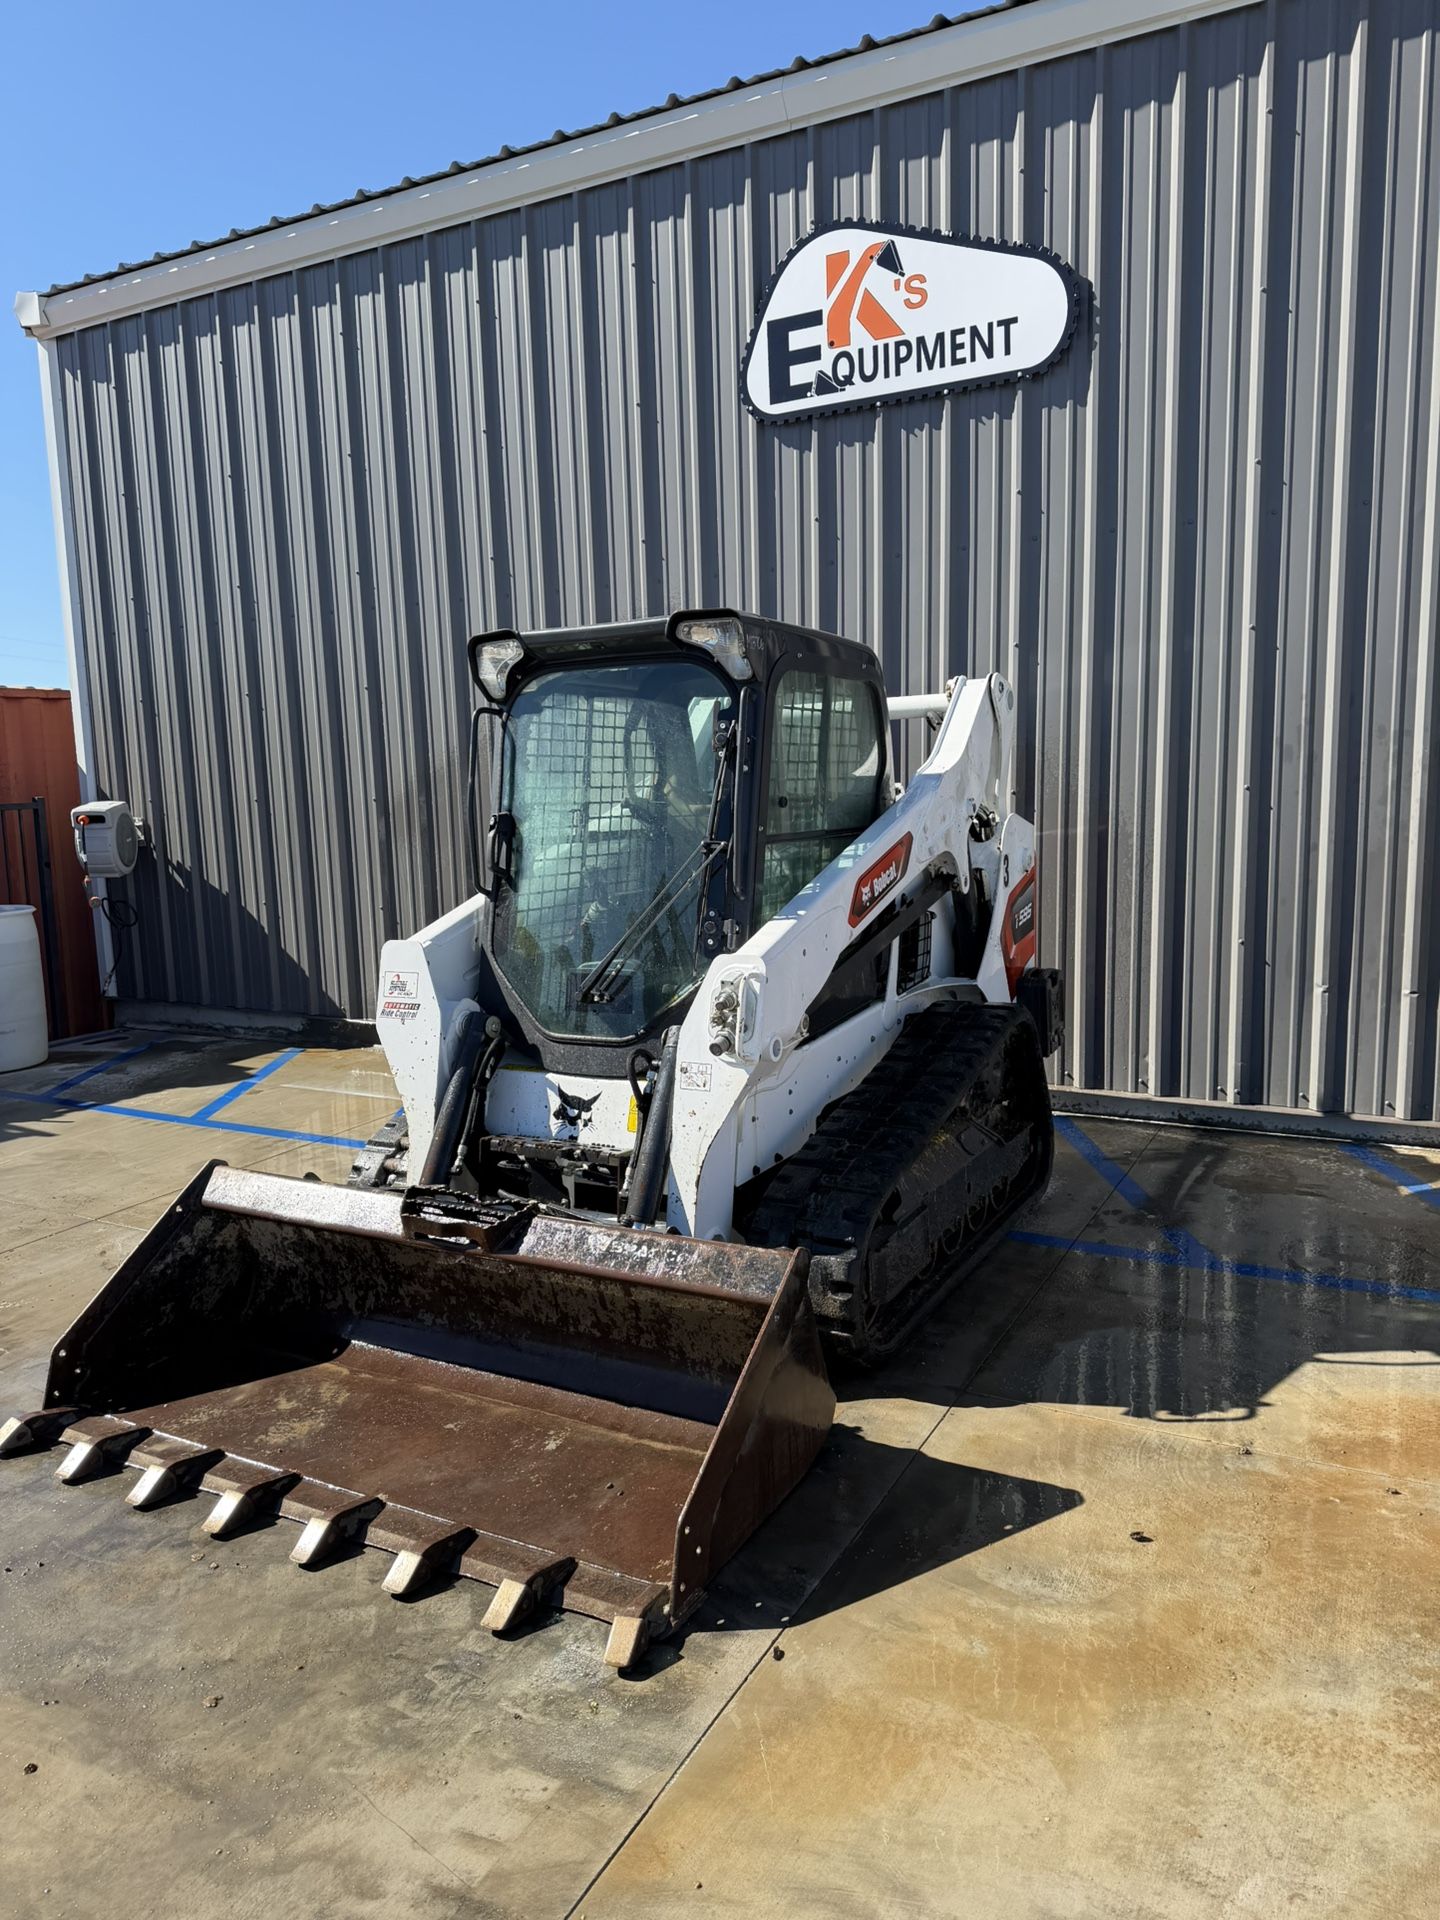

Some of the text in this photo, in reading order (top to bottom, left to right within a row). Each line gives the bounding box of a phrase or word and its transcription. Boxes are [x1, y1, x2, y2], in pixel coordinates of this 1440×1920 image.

[873, 861, 897, 897] Bobcat
[1003, 854, 1010, 888] 3
[380, 1009, 418, 1019] Ride Control
